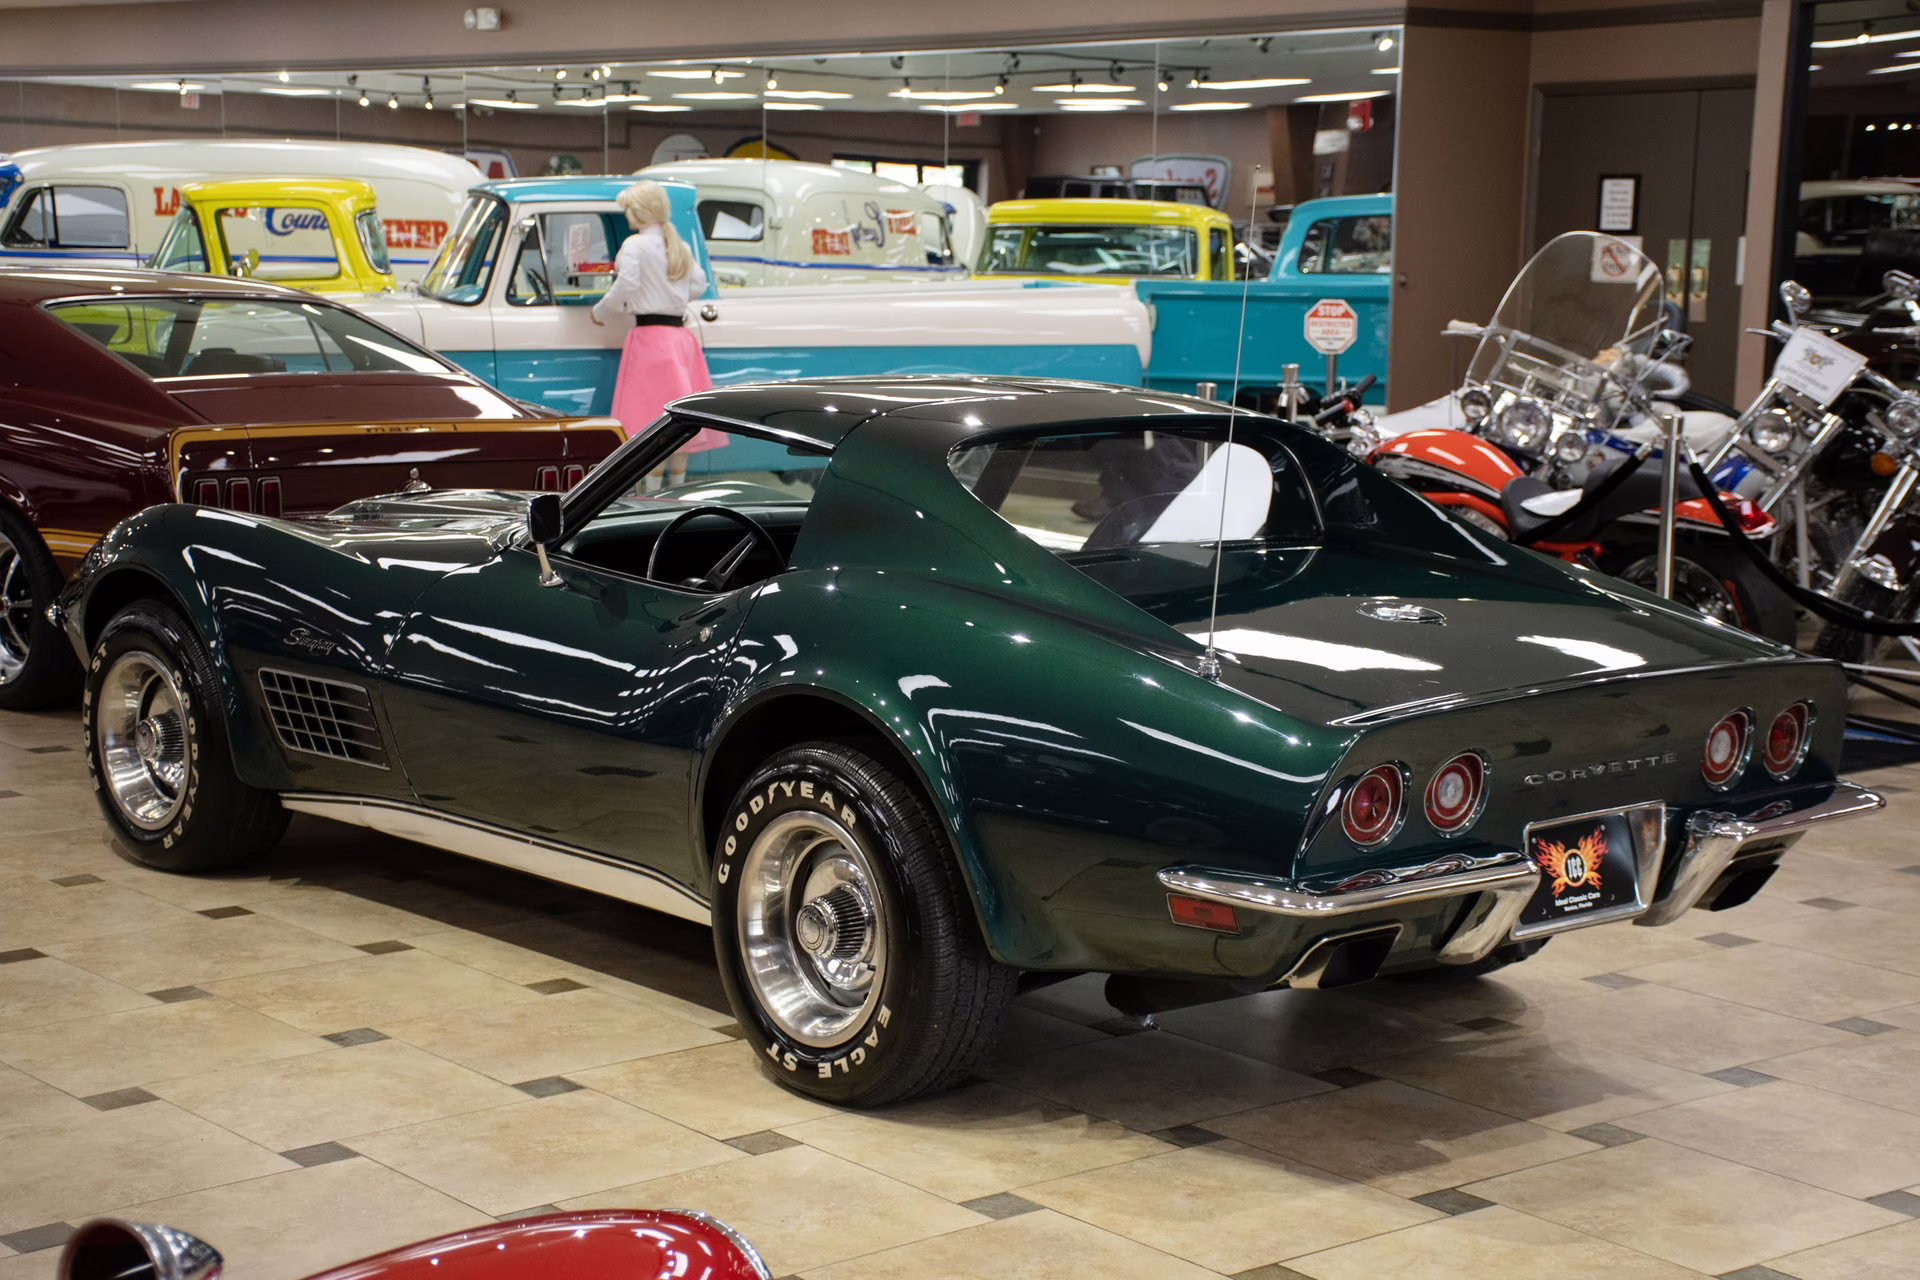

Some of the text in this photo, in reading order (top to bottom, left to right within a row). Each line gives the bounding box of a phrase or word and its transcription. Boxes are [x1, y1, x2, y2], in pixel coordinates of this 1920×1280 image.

[383, 219, 449, 249] INER
[1317, 304, 1345, 317] STOP
[283, 627, 337, 657] Stingray
[1524, 751, 1680, 786] CORVETTE
[717, 780, 858, 885] GOODYEAR
[766, 1040, 799, 1073] ST
[818, 1004, 892, 1080] EAGLE
